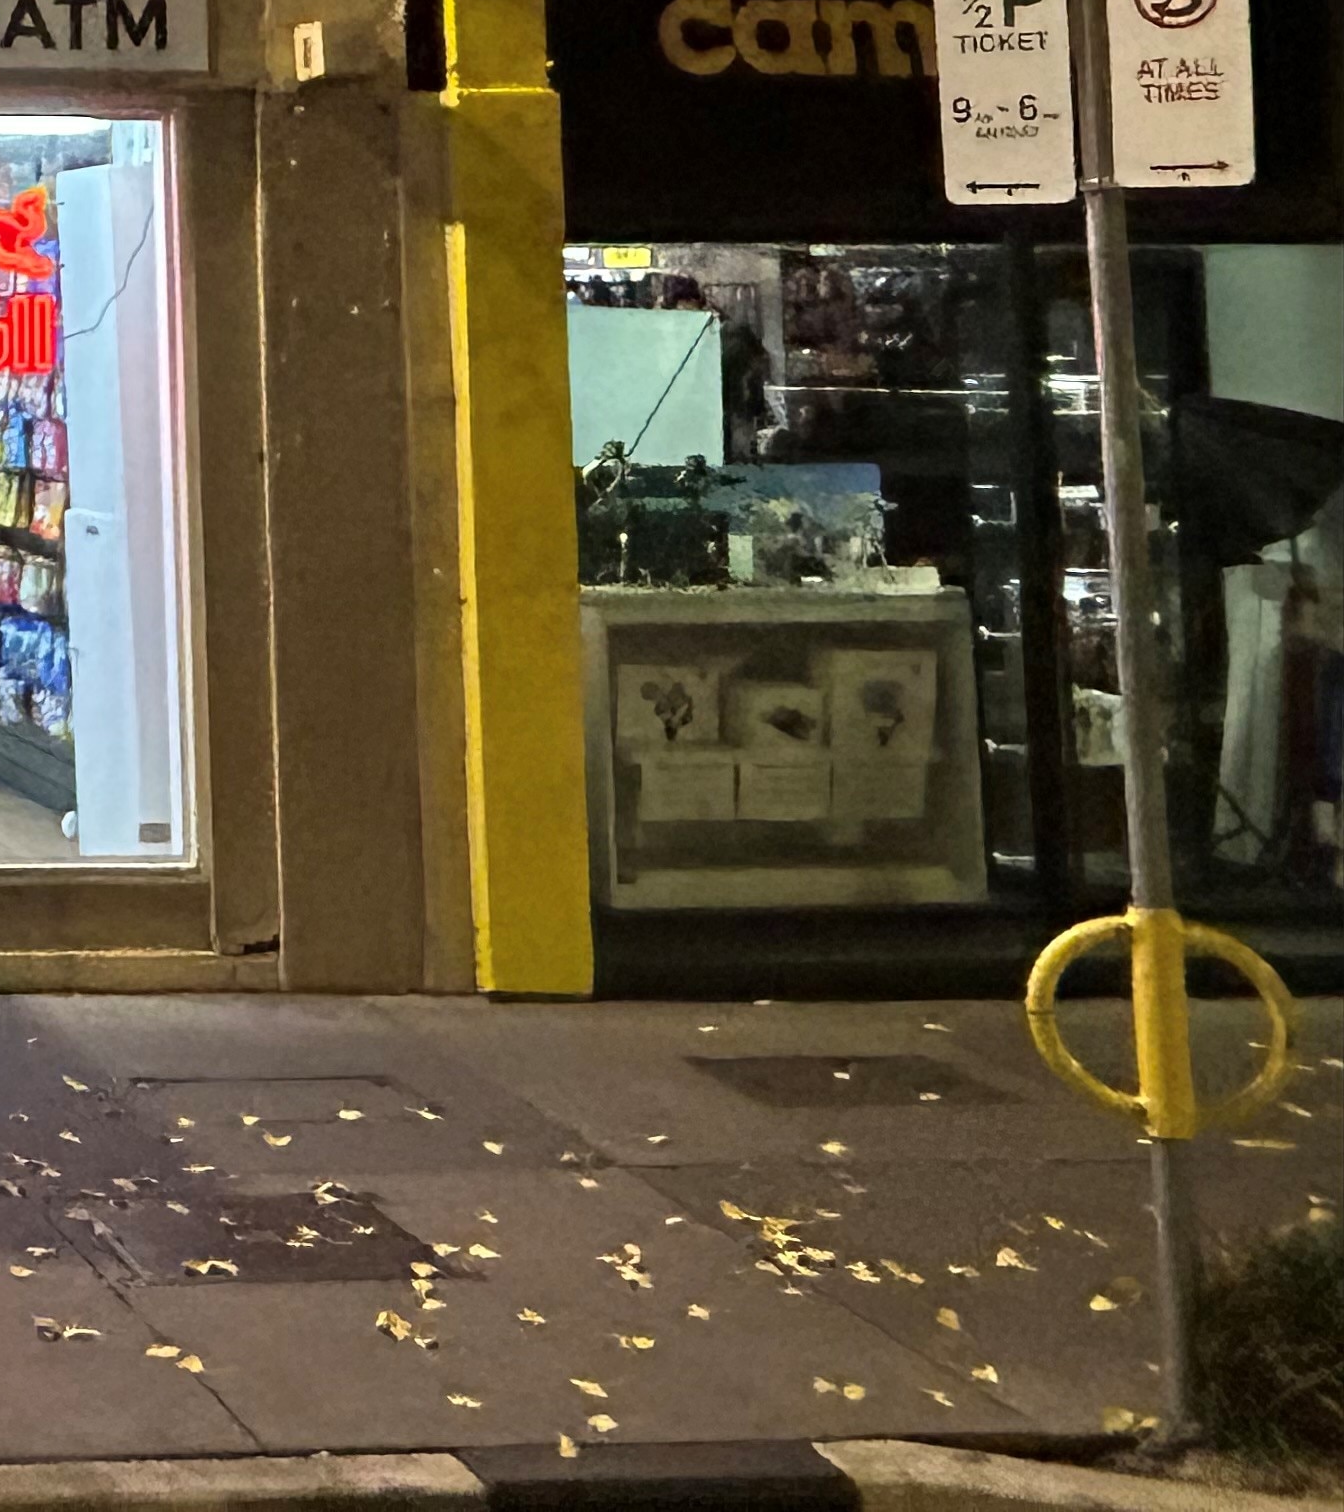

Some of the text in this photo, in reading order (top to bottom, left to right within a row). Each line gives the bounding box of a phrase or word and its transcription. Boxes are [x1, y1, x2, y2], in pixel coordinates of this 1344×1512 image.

[953, 30, 1049, 55] TICKET
[1136, 57, 1225, 81] AT ALL
[1140, 81, 1221, 104] TIMES
